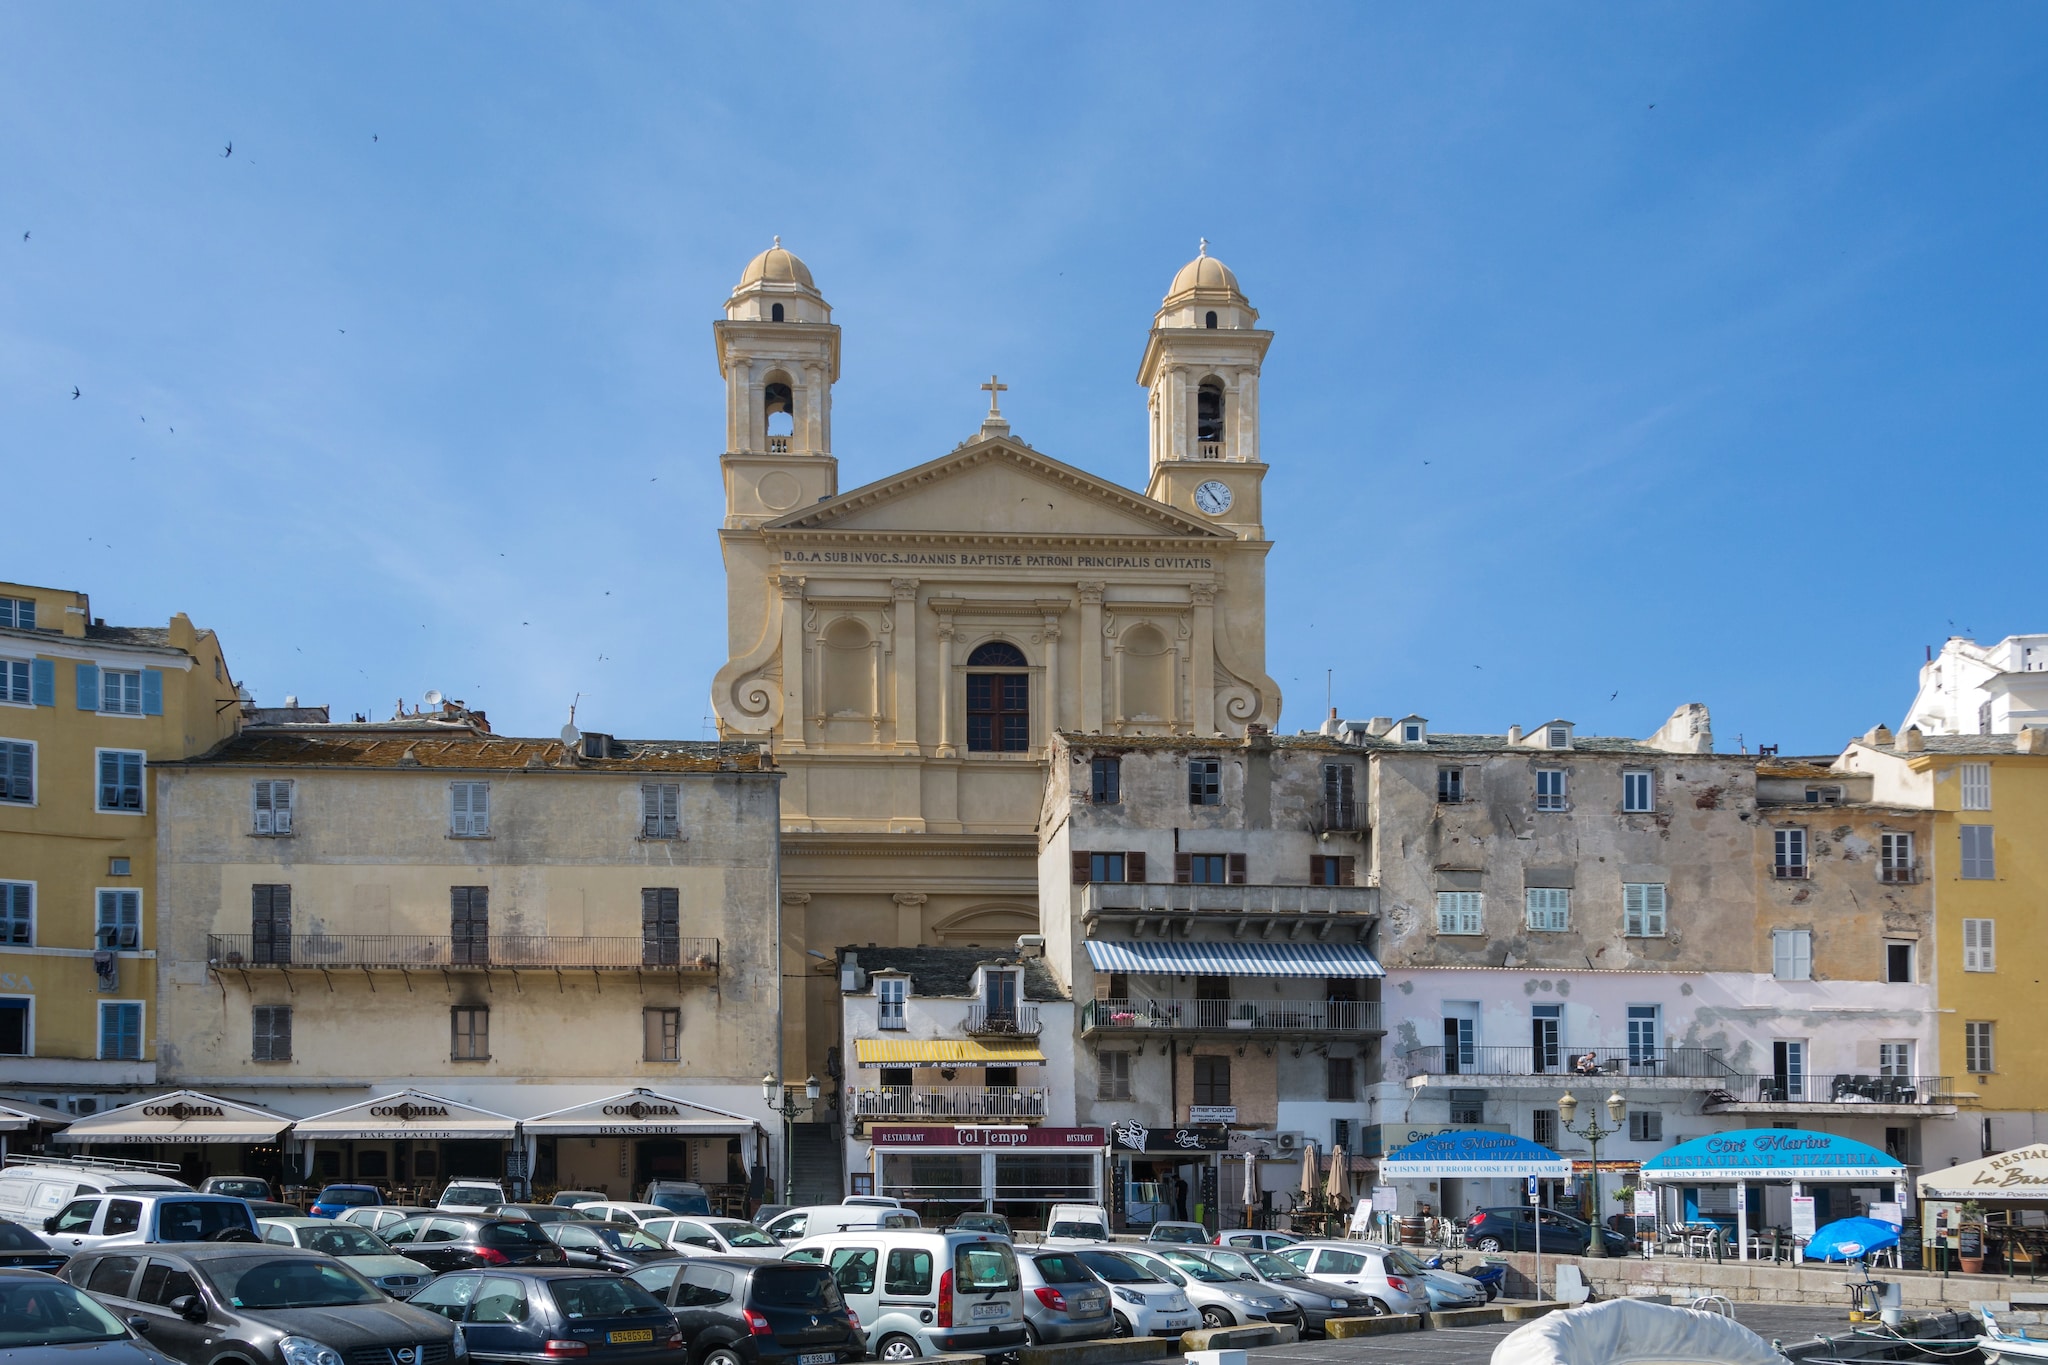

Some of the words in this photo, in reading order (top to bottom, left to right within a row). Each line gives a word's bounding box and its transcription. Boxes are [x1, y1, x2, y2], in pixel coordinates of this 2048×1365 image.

[824, 552, 848, 563] SUB
[1026, 555, 1073, 567] PATRONI
[1077, 556, 1150, 568] PRINCIPALIS
[1154, 558, 1211, 569] CIVITATIS
[142, 1105, 225, 1117] COLOMBA
[370, 1105, 449, 1117] COLOMBA
[602, 1104, 680, 1116] COLOMBA
[600, 1126, 678, 1134] BRASSERIE
[124, 1135, 209, 1143] BRASSERIE
[882, 1133, 925, 1142] RESTAURANT
[957, 1129, 978, 1145] Col
[982, 1129, 1028, 1146] Tempo
[1066, 1134, 1094, 1142] BISTROT
[1461, 1136, 1518, 1150] Marine
[1706, 1137, 1746, 1153] Côté
[1753, 1135, 1832, 1150] Marine
[1400, 1152, 1477, 1160] RESTAURANT
[1491, 1151, 1551, 1160] PIZZERIA
[1662, 1154, 1776, 1167] RESTAURANT
[1792, 1153, 1880, 1166] PIZZERIA
[1531, 1165, 1542, 1173] LA
[1544, 1165, 1563, 1173] MER
[1859, 1168, 1879, 1176] MER
[1972, 1170, 2000, 1185] La
